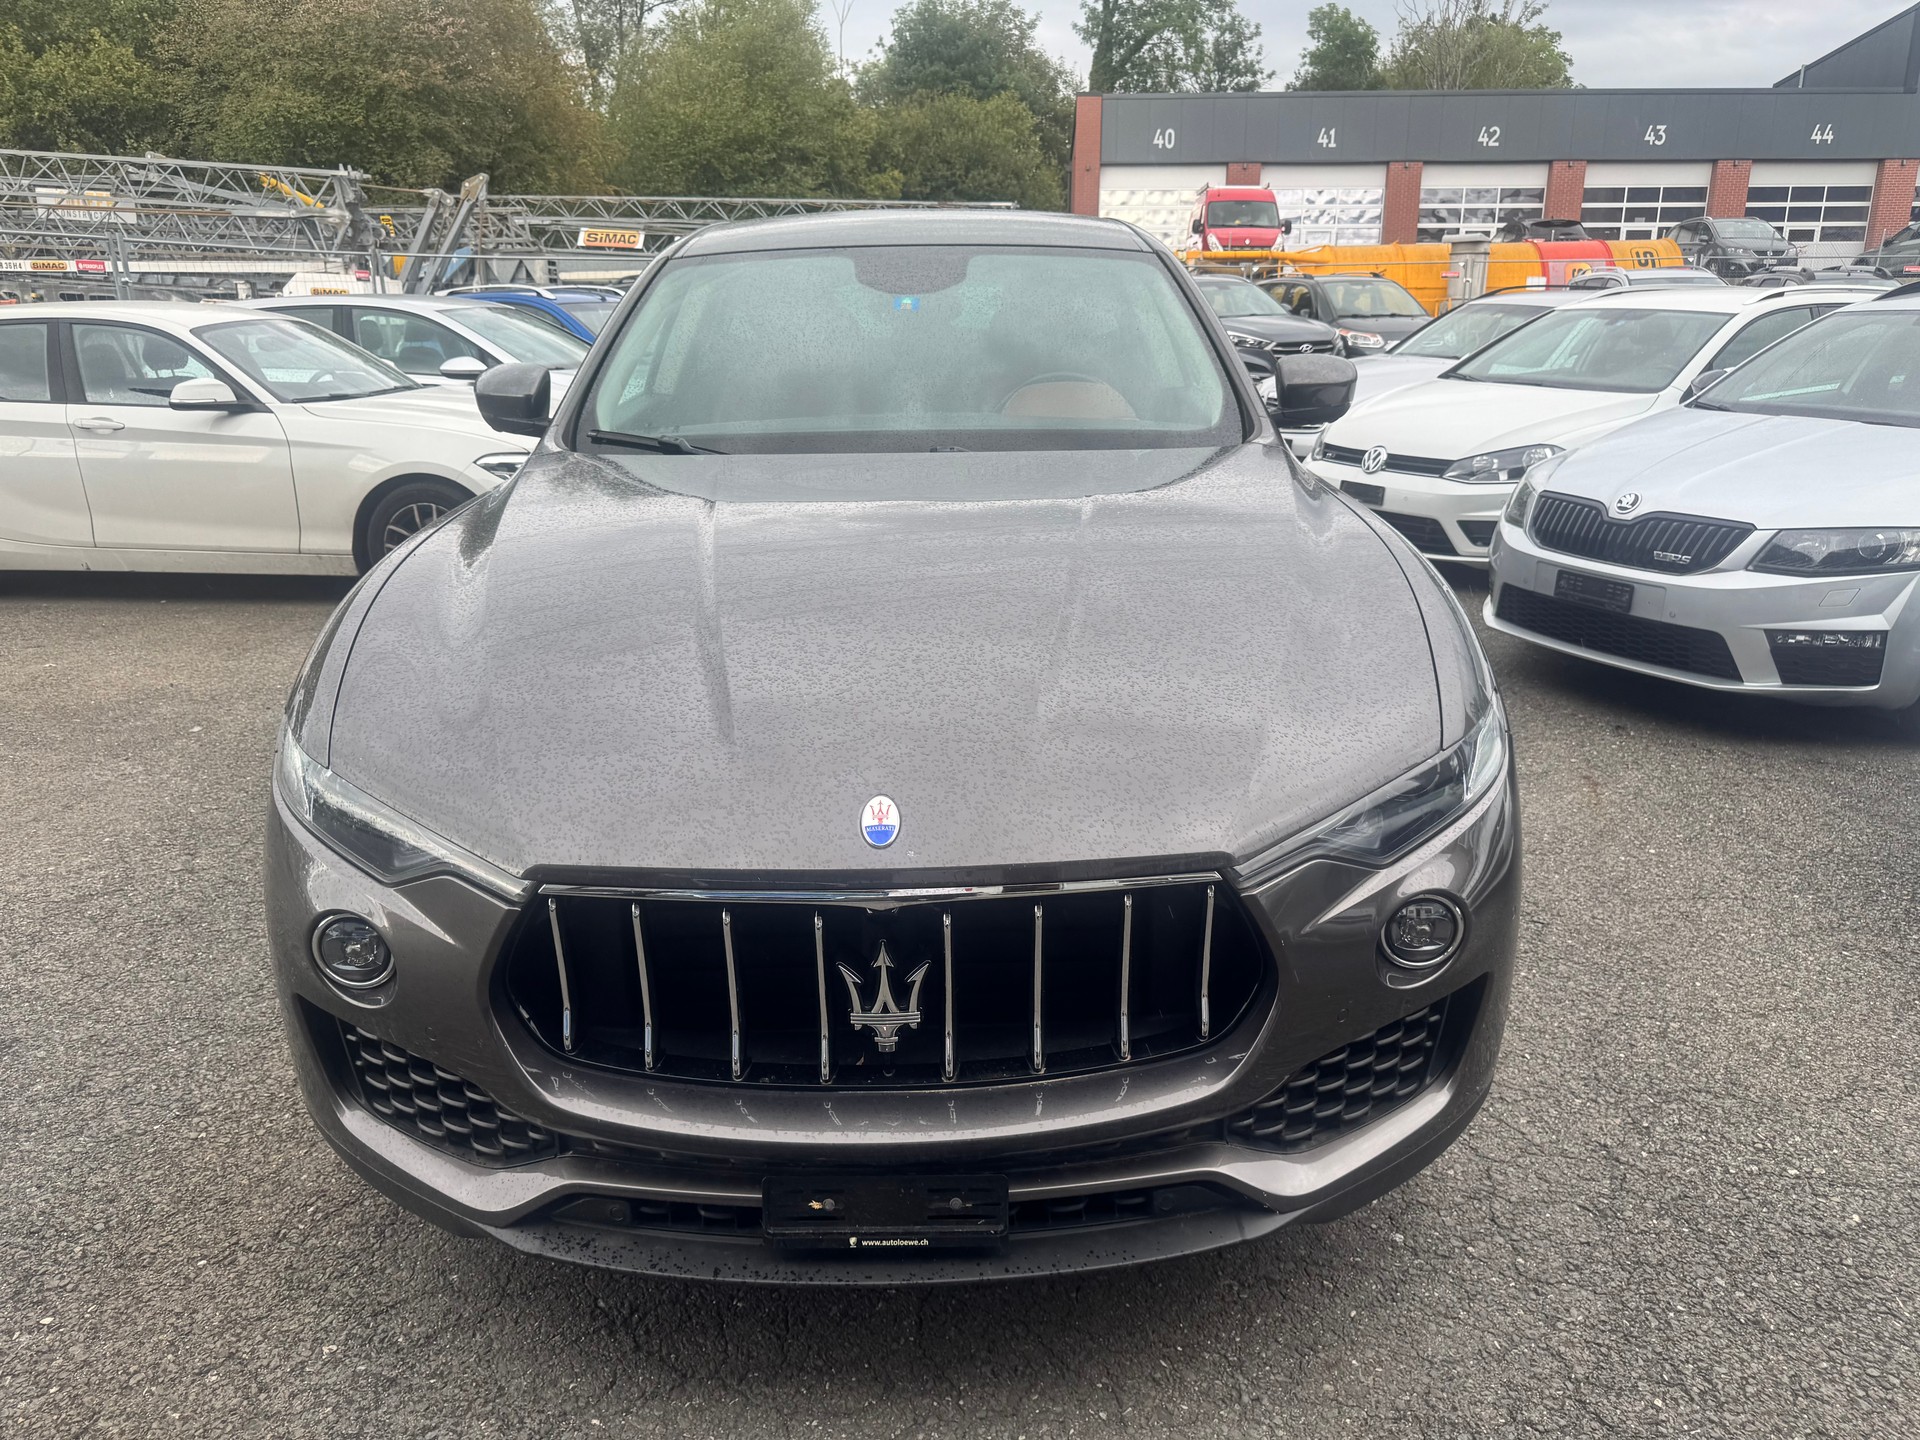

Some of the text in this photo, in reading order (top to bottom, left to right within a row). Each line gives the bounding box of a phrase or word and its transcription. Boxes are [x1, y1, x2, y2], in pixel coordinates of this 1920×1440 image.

[1153, 128, 1175, 149] 40
[1317, 127, 1337, 148] 41
[1477, 126, 1500, 147] 42
[1644, 125, 1667, 146] 43
[1810, 123, 1834, 144] 44
[861, 1238, 929, 1246] www.autoloewe.ch
